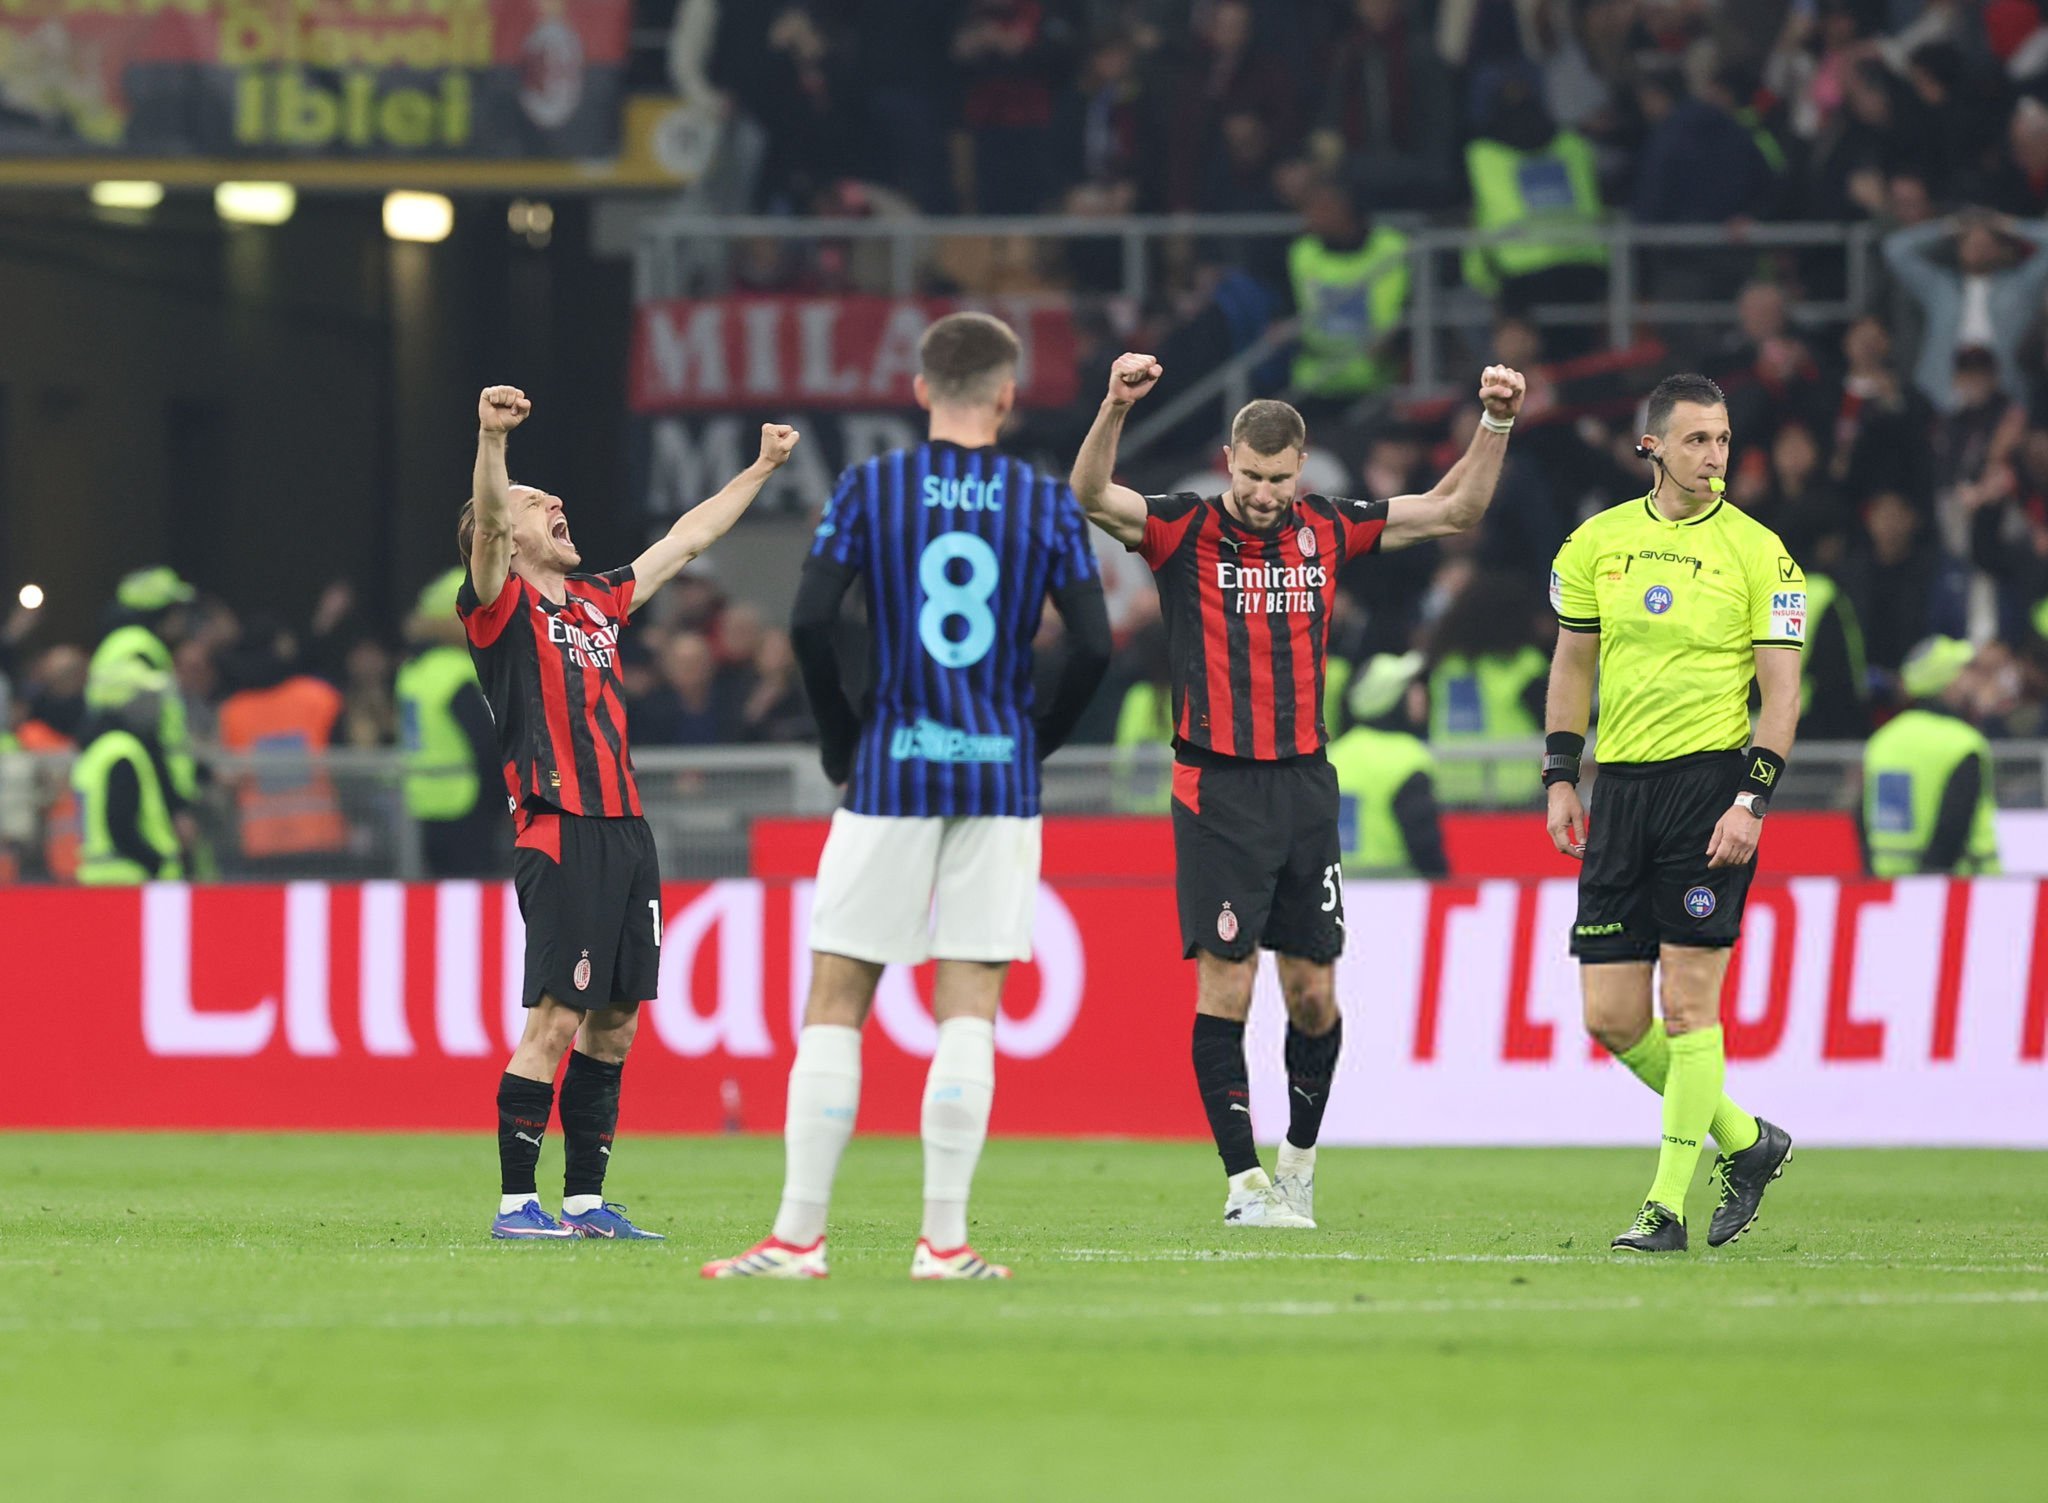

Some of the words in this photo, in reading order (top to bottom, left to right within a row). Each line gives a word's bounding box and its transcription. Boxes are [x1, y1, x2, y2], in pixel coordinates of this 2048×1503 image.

[1216, 561, 1327, 589] Emirates
[1639, 550, 1697, 565] GIVOVA
[919, 530, 999, 669] 8
[1236, 591, 1262, 614] FLY
[1265, 591, 1316, 613] BETTER
[1320, 862, 1345, 912] 31
[648, 899, 663, 947] 1
